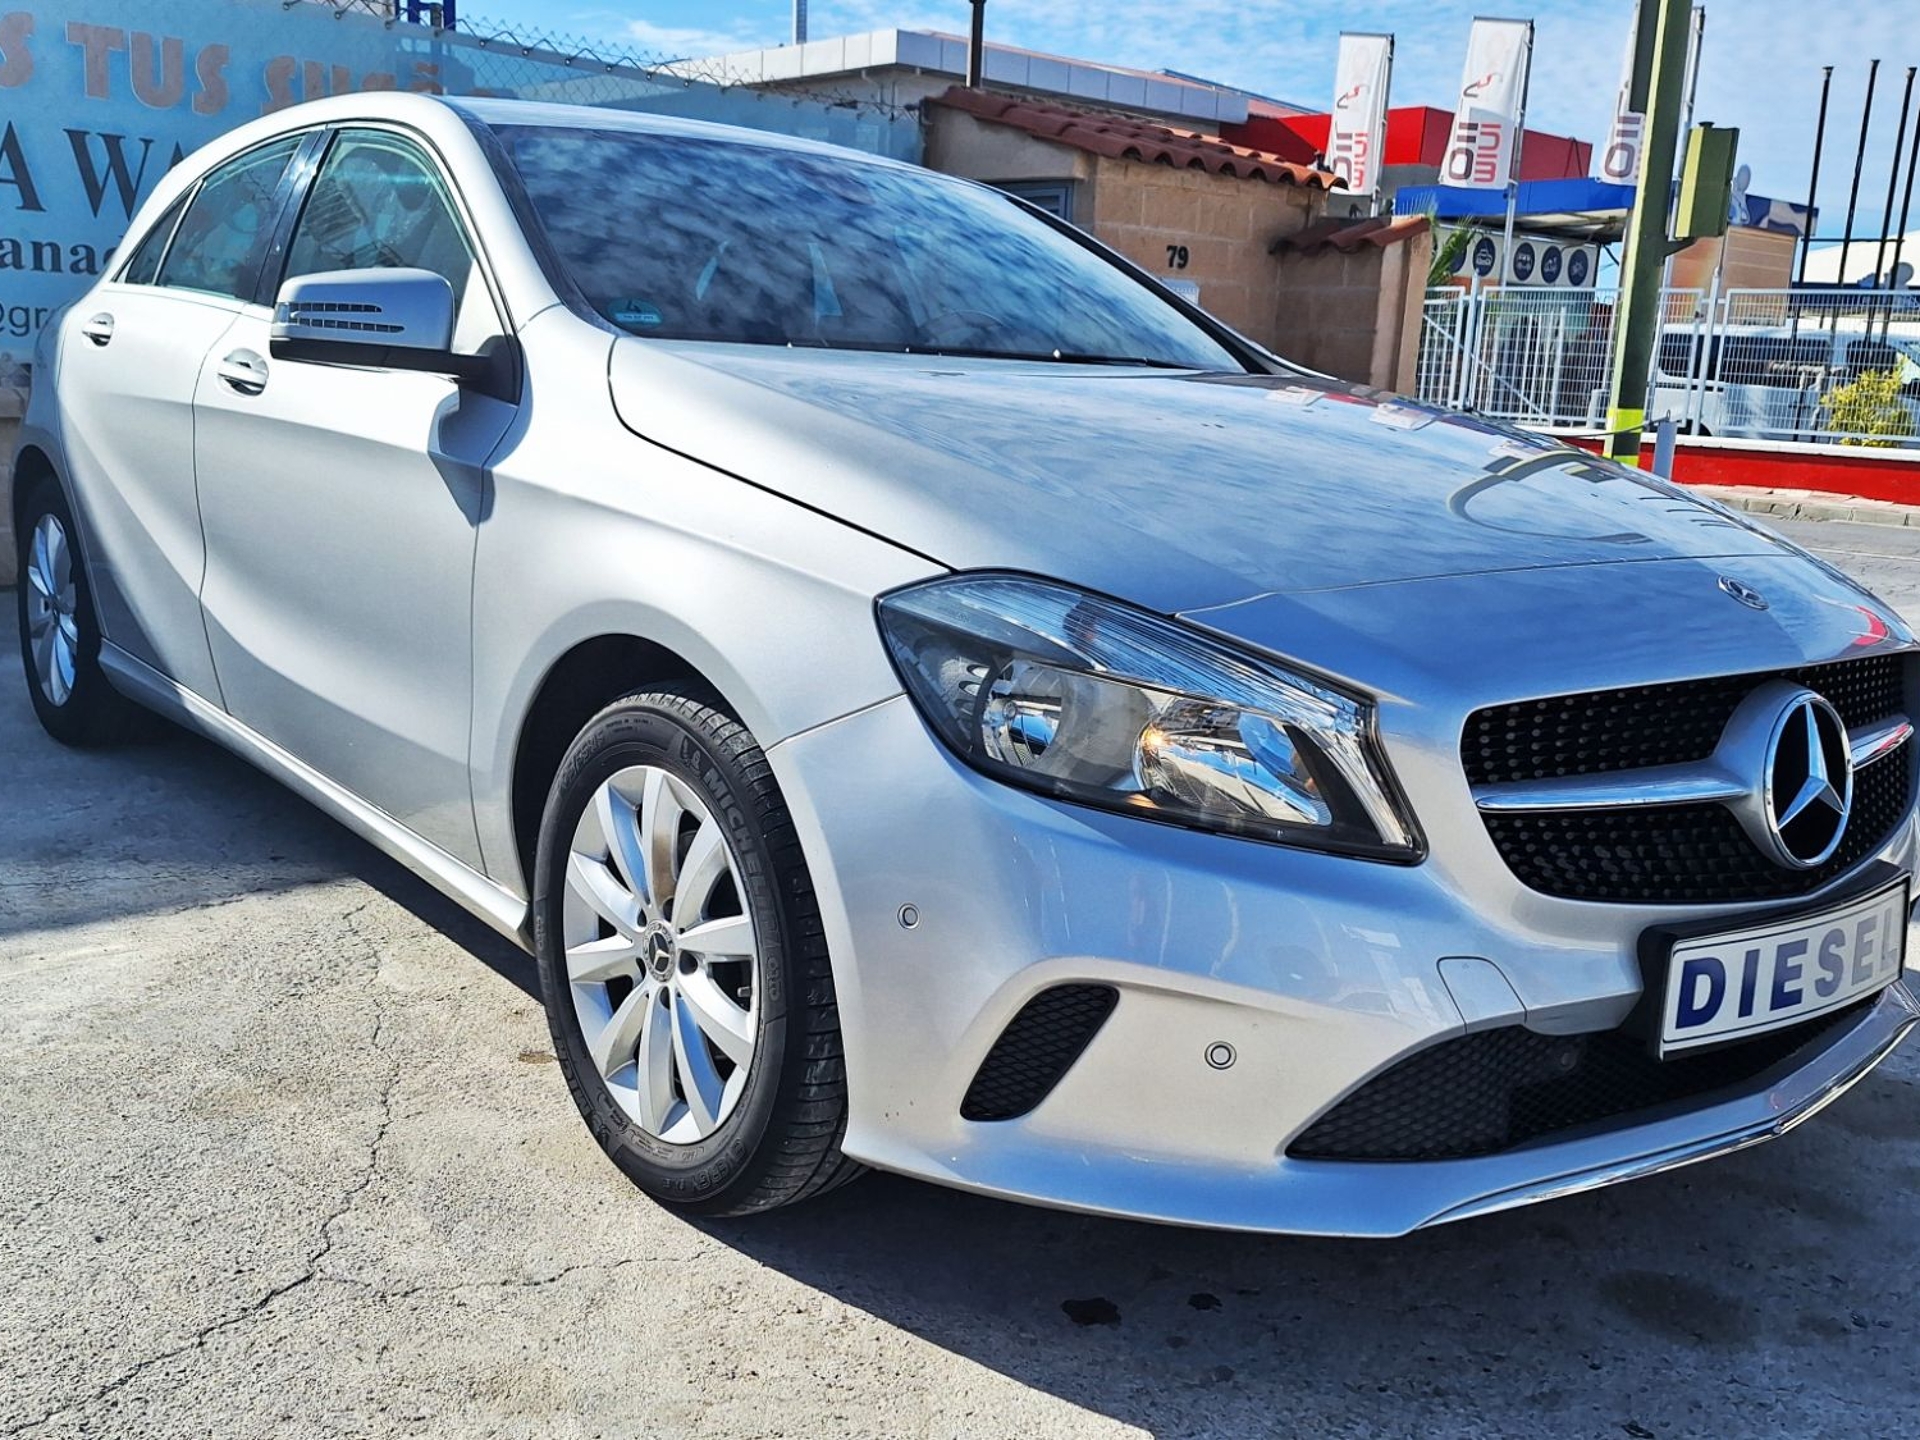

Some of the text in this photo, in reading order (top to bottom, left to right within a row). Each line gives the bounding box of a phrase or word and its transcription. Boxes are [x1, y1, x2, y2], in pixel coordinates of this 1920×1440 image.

[65, 20, 230, 115] TUS
[63, 128, 184, 222] W
[0, 236, 123, 275] ana
[1166, 245, 1189, 269] 79
[1675, 907, 1898, 1029] DIESEL
